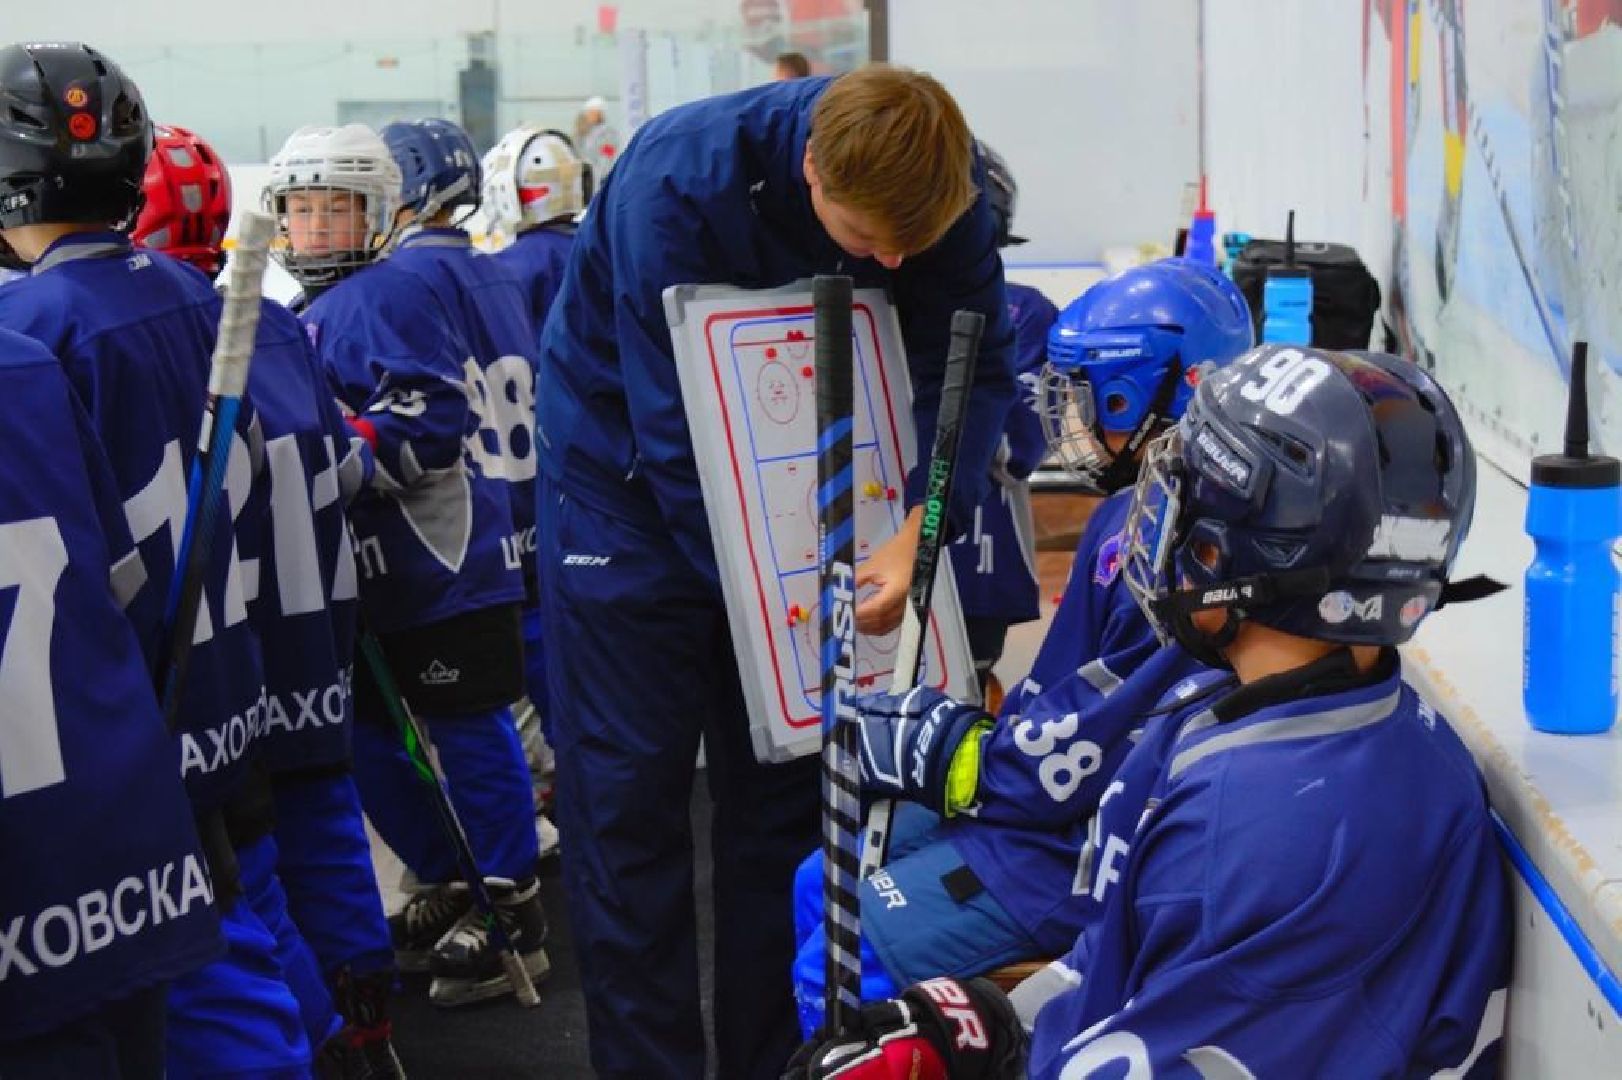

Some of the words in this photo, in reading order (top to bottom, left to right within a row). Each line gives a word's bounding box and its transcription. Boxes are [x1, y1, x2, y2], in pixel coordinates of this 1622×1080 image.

[1240, 348, 1331, 416] 90
[1013, 712, 1103, 802] 38
[0, 852, 214, 982] ХОВСКА
